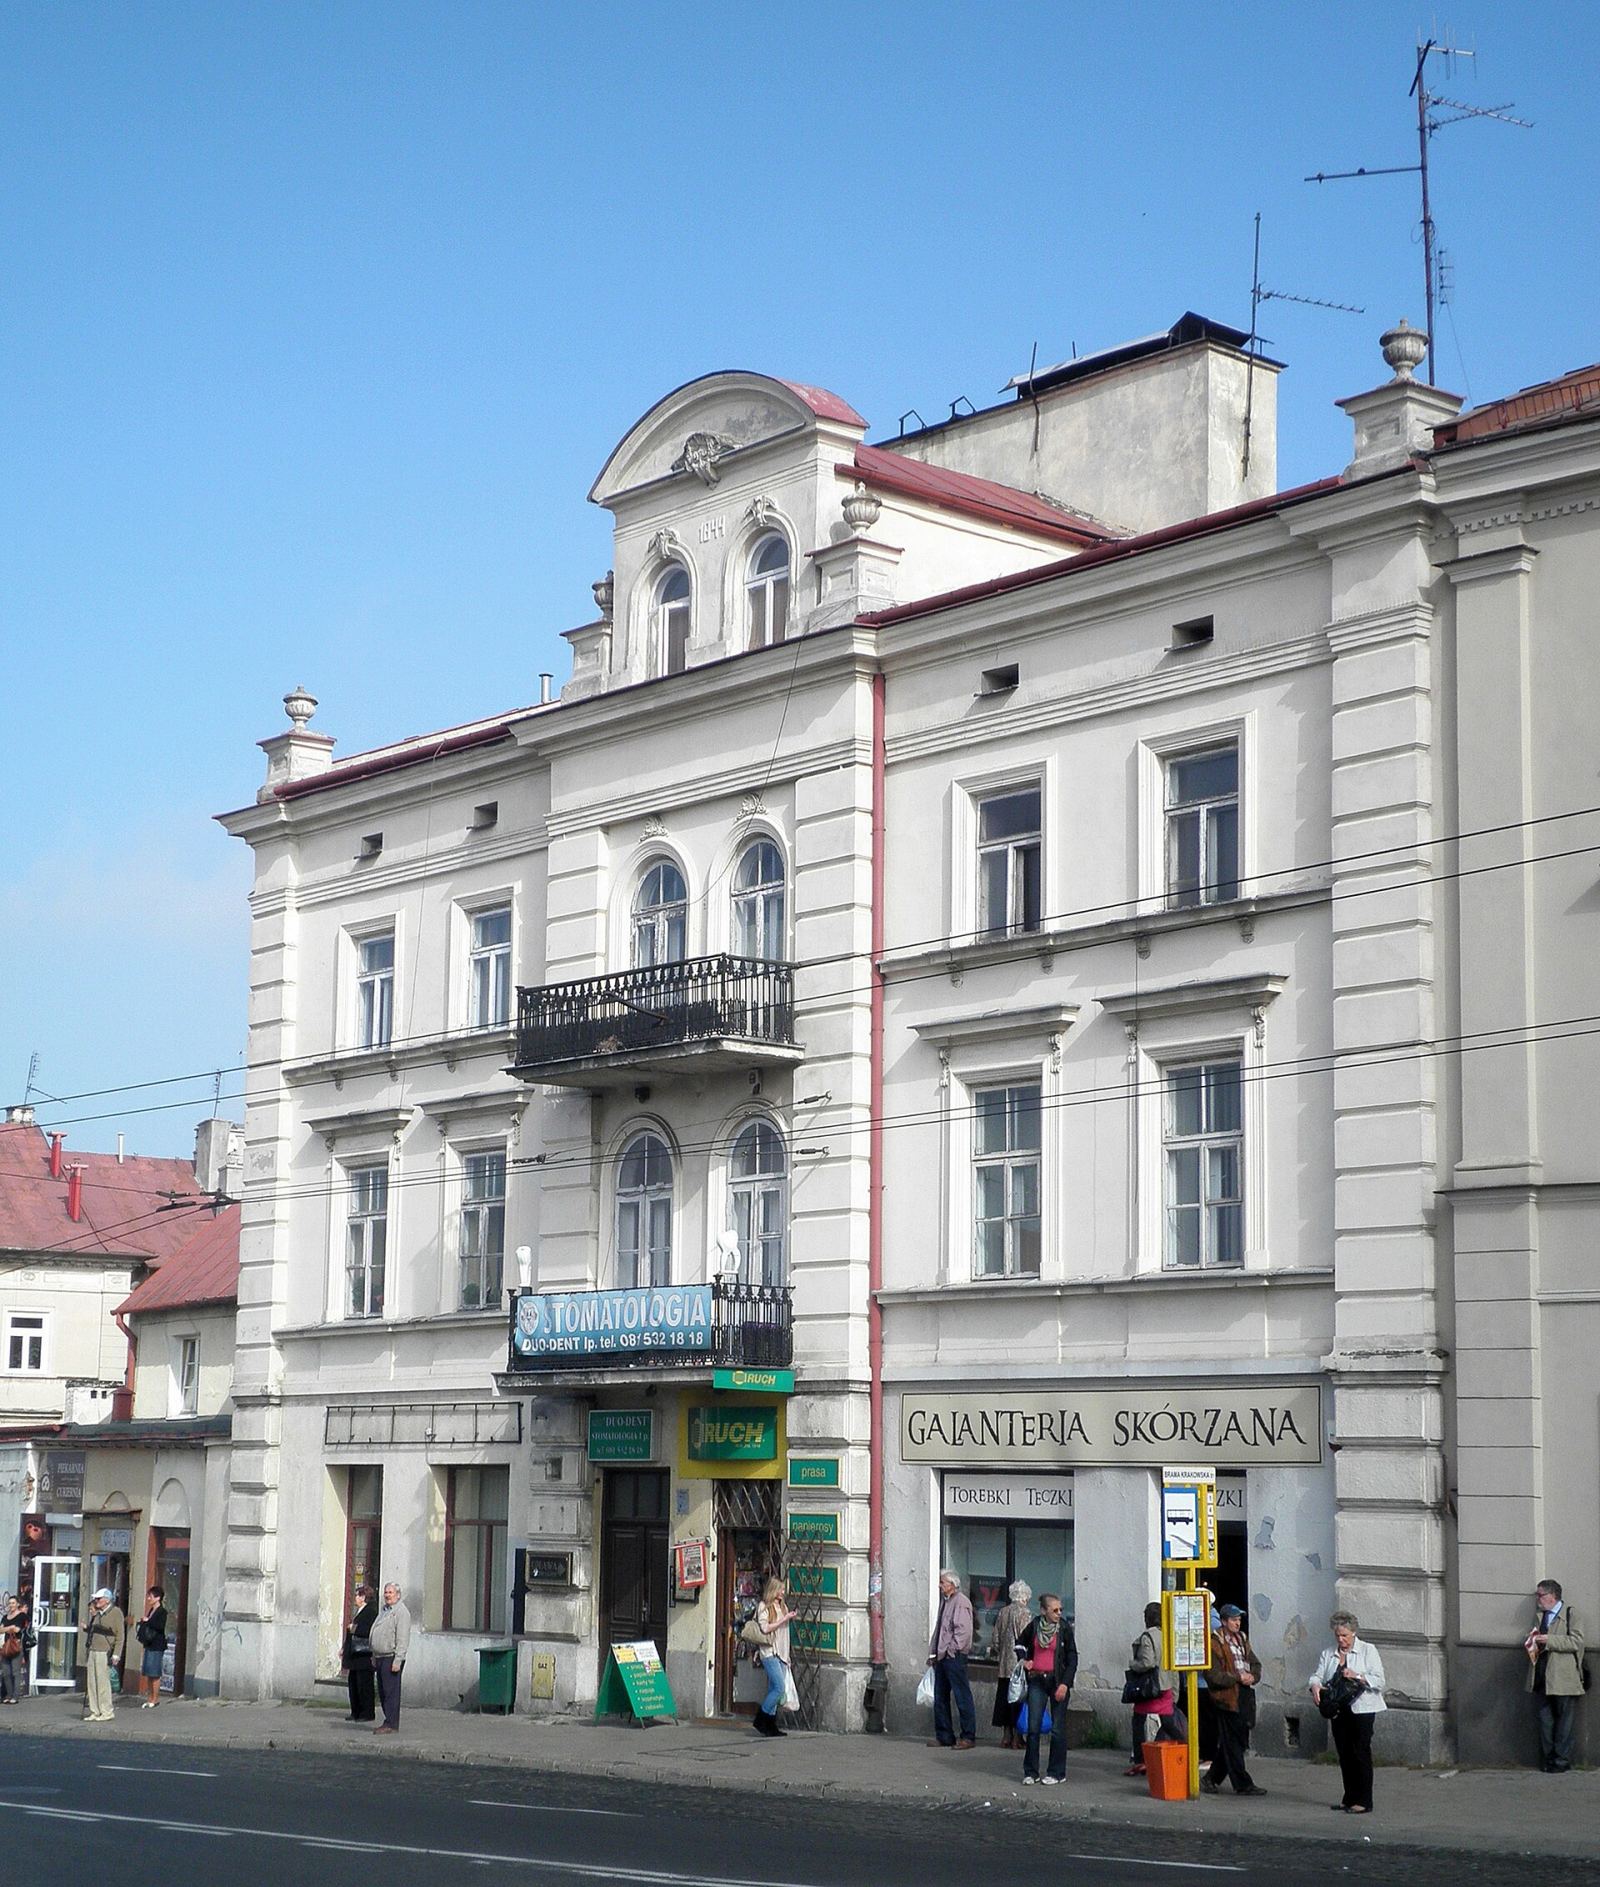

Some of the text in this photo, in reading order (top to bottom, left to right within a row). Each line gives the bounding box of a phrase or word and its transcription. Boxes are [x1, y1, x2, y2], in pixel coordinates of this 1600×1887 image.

[600, 1334, 617, 1349] tel.
[643, 1332, 666, 1346] 532
[670, 1331, 684, 1345] 18
[689, 1331, 703, 1345] 18
[747, 1373, 776, 1385] RUCH
[704, 1422, 764, 1443] RUCH
[908, 1403, 1307, 1446] GALANTERIA SKÓRZANA
[801, 1467, 826, 1480] prasa
[950, 1486, 1072, 1506] TOREBKI TECZKI
[1216, 1489, 1243, 1507] ZKI
